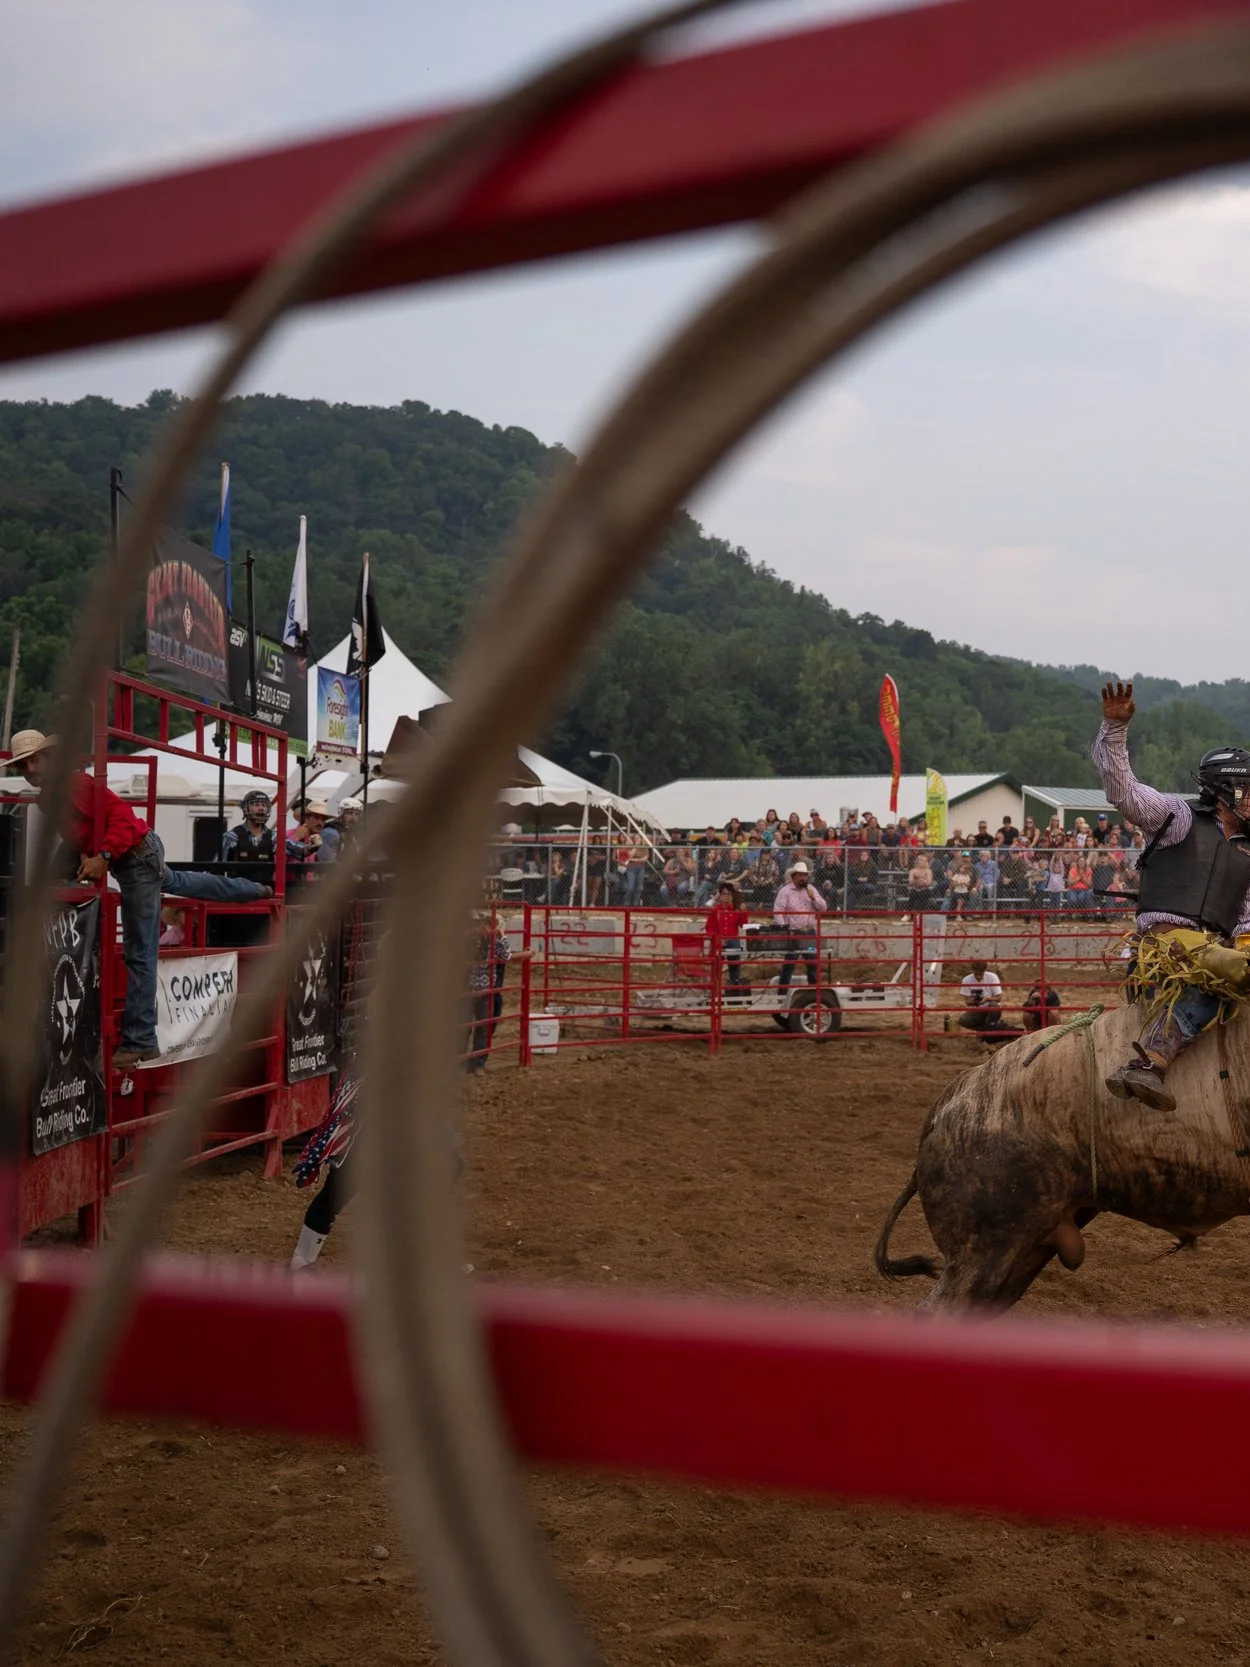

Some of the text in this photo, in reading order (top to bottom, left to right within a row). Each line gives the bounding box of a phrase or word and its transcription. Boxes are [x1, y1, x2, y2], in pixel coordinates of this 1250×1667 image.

[328, 718, 346, 740] BANK
[59, 1076, 86, 1101] Frontier
[53, 1109, 74, 1133] Riding
[74, 1104, 90, 1125] Co.
